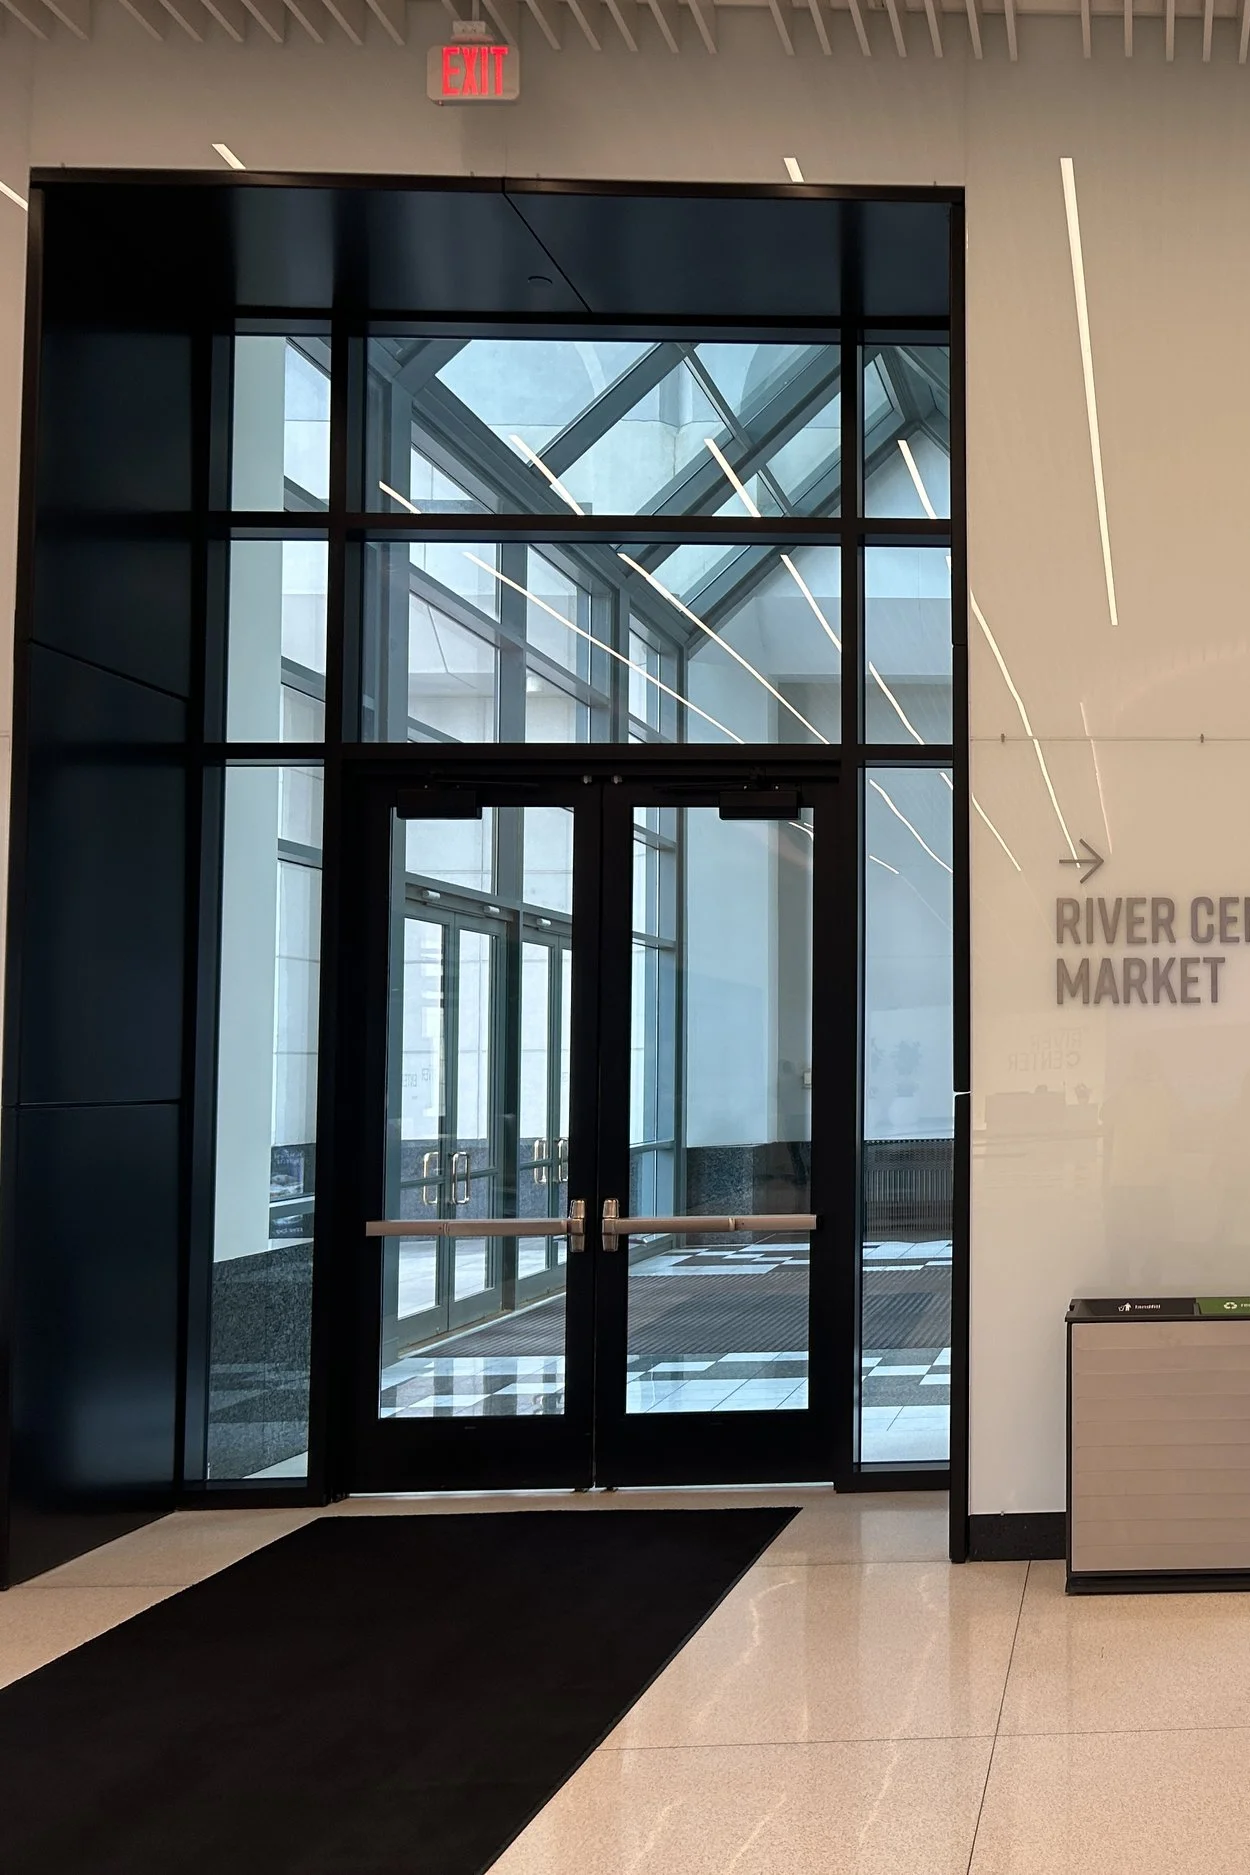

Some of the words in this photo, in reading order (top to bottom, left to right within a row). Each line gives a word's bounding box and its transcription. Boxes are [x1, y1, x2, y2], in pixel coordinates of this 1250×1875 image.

[442, 46, 508, 96] EXIT
[1056, 897, 1177, 944] RIVER
[1056, 957, 1226, 1005] MARKET
